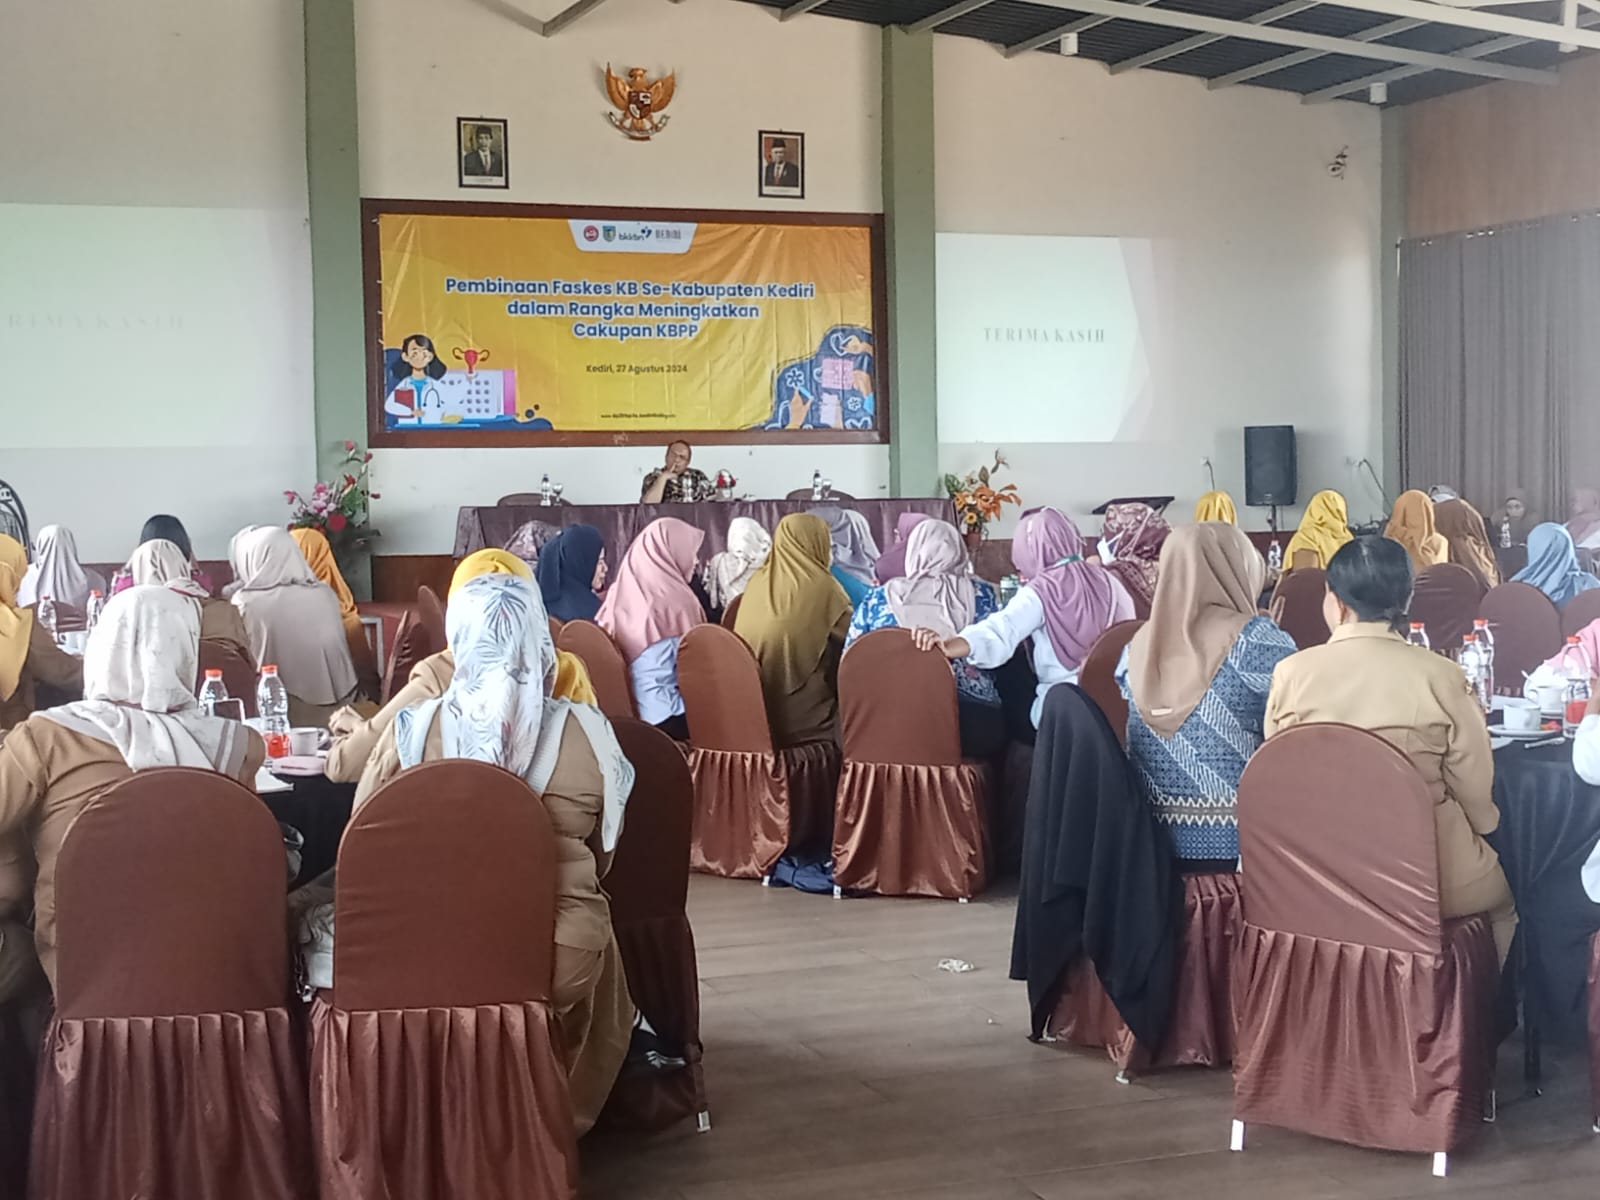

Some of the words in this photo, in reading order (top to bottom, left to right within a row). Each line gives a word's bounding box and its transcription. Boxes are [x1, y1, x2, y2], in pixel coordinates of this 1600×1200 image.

[445, 278, 548, 294] Pembinaan
[553, 280, 611, 295] Faskes
[616, 281, 638, 295] KB
[642, 282, 763, 300] Se-Kabupaten
[767, 283, 814, 297] Kediri
[507, 301, 564, 315] dalam
[569, 302, 634, 319] Rangka
[639, 303, 759, 320] Meningkatkan
[574, 323, 652, 340] Cakupan
[656, 324, 698, 337] KBPP
[984, 327, 1050, 343] TERIMA
[1055, 328, 1105, 343] KASIH
[586, 364, 615, 374] Kediri,
[616, 365, 627, 373] 27
[628, 365, 665, 375] Agustus
[666, 365, 688, 373] 2024
